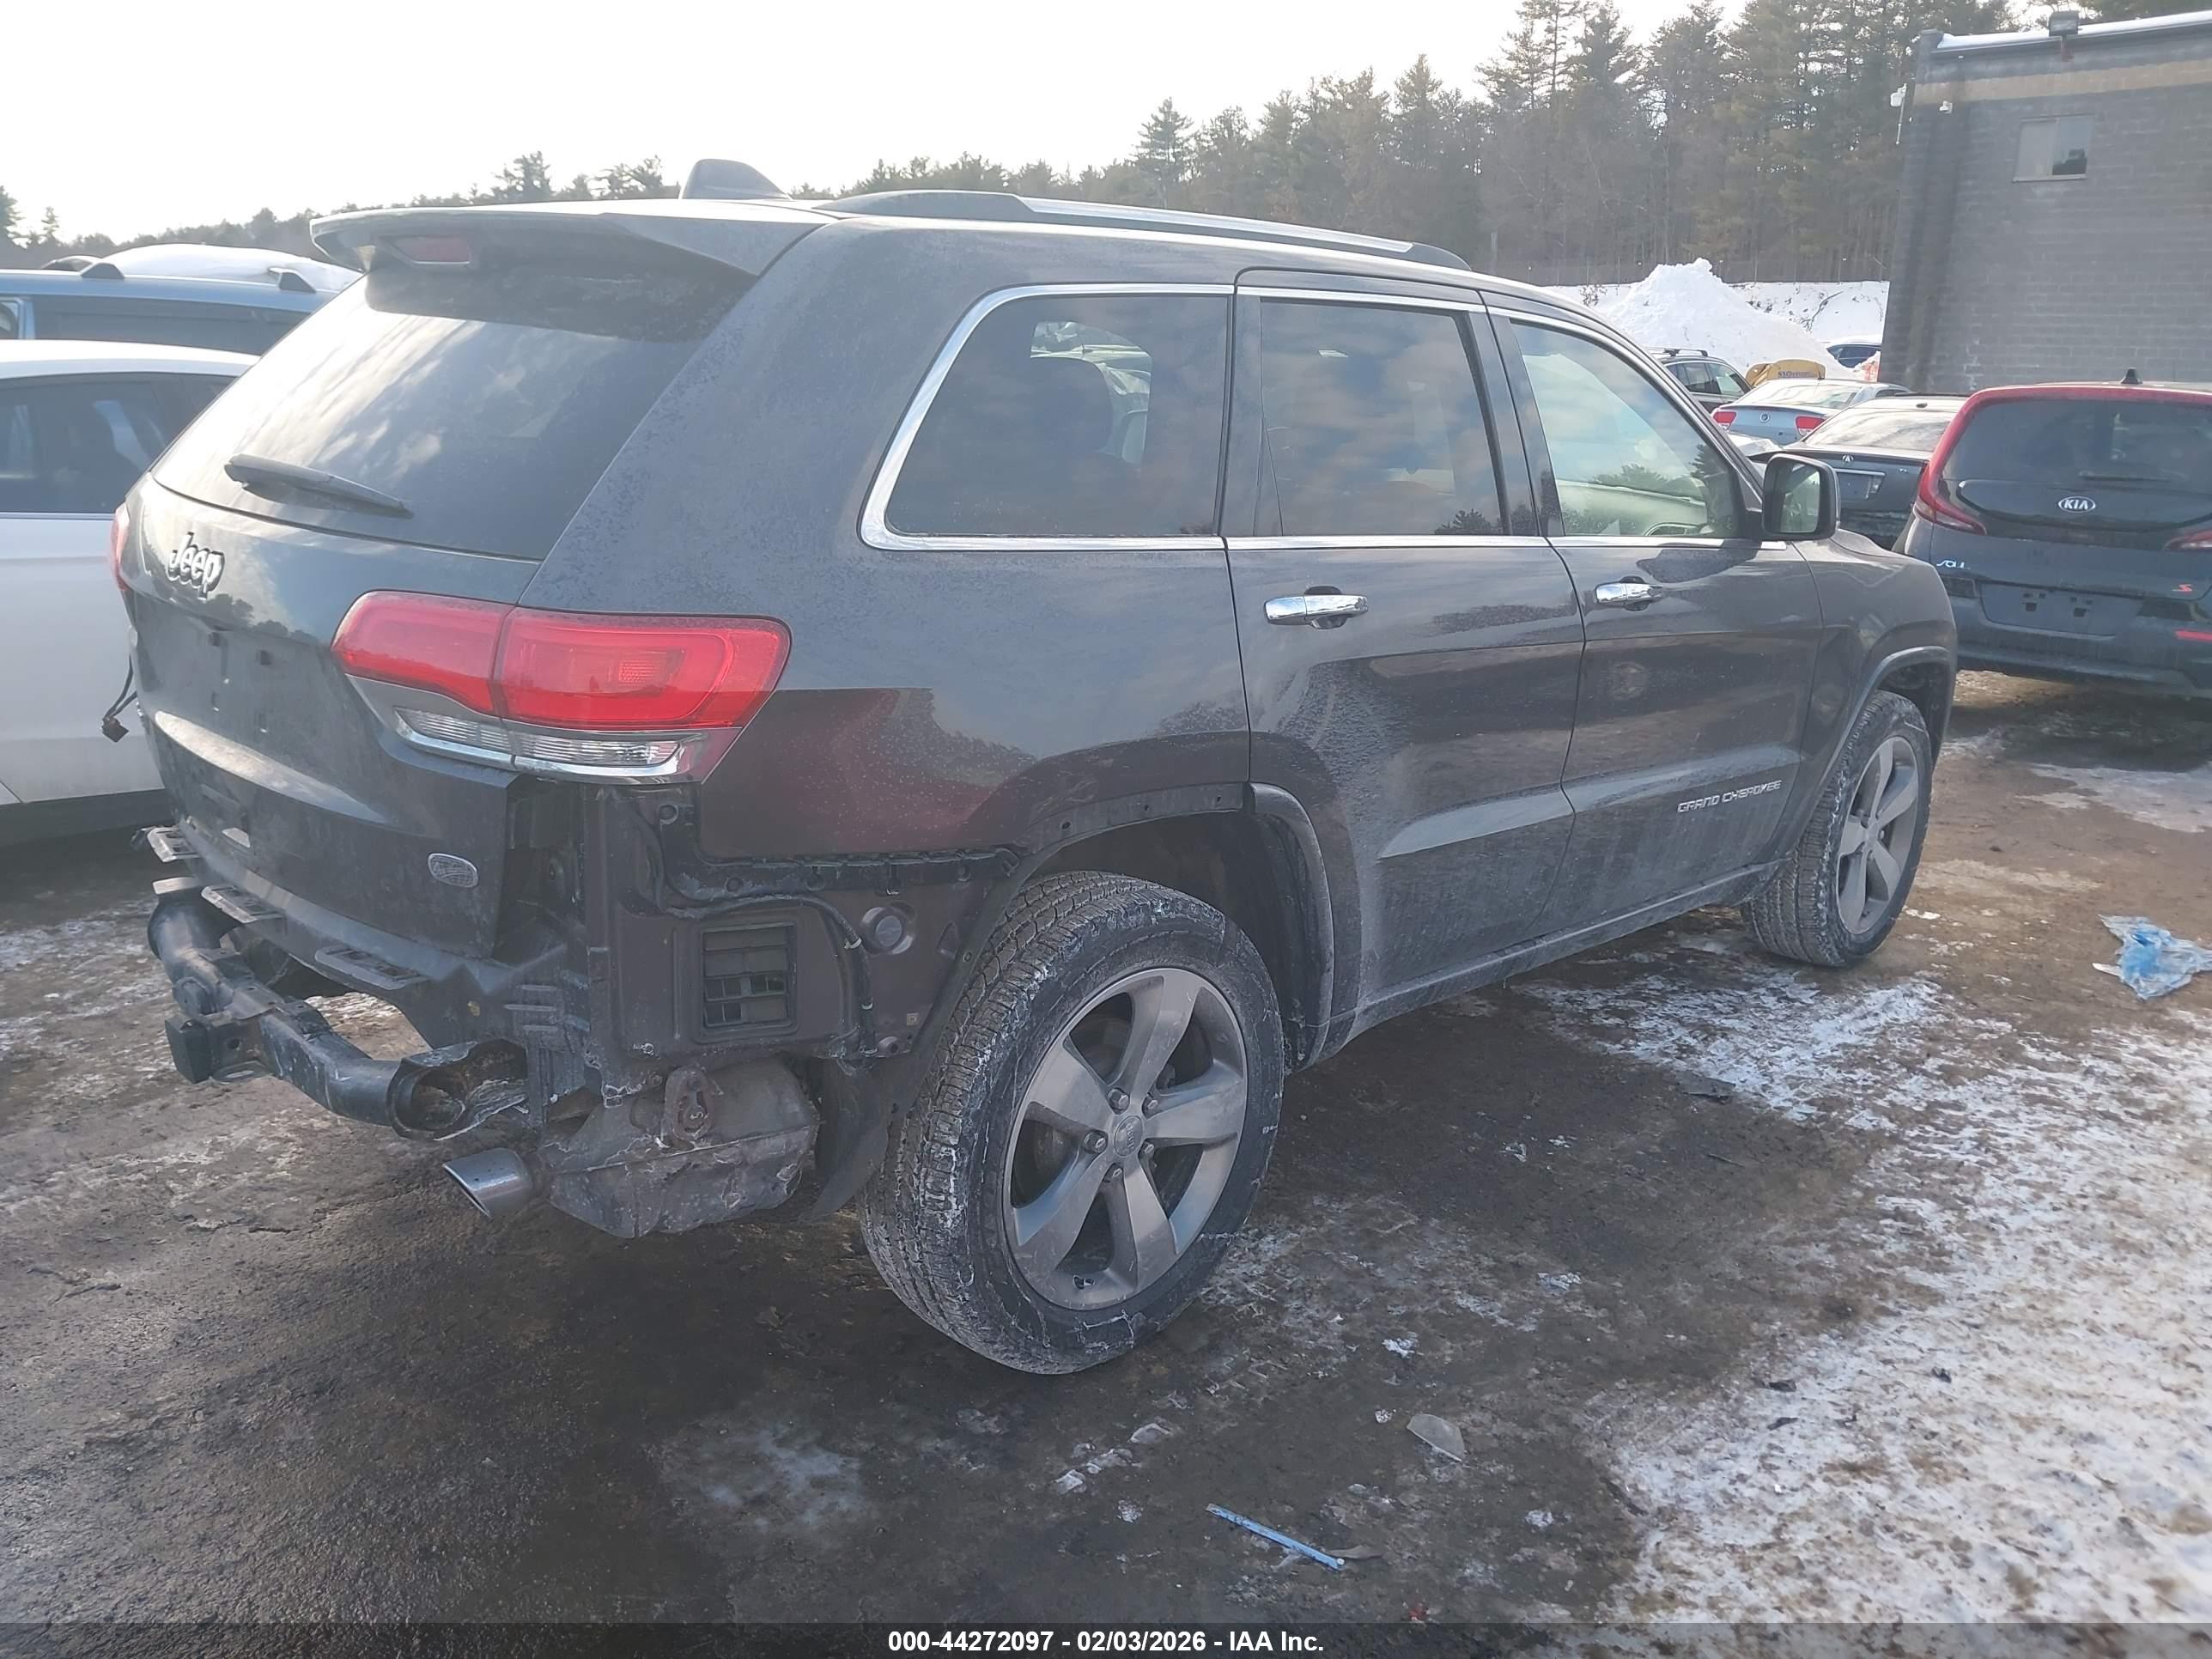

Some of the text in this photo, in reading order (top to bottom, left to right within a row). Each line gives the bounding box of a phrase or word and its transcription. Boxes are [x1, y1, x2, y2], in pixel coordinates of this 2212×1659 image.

[2063, 498, 2089, 510] KIA
[167, 531, 226, 599] Jeep
[1677, 780, 1783, 813] GRAND CHEROKEE
